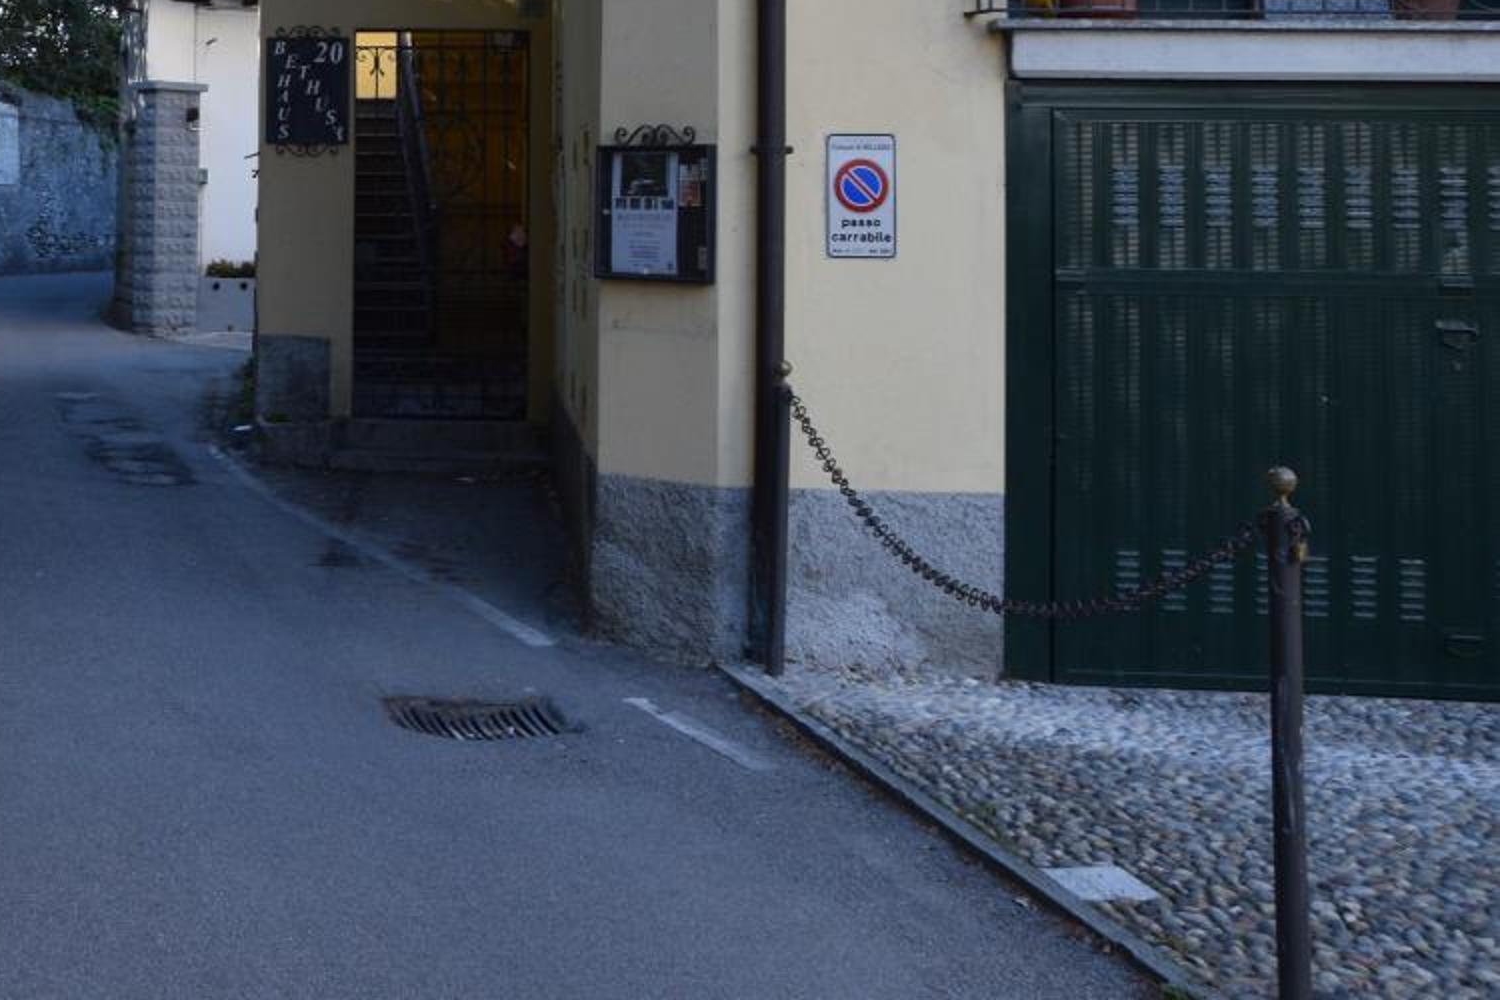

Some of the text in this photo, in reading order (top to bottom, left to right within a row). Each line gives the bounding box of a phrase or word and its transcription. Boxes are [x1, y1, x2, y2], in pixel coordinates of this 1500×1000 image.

[313, 41, 344, 64] 20
[841, 218, 881, 229] passo
[831, 231, 892, 243] carrabile
